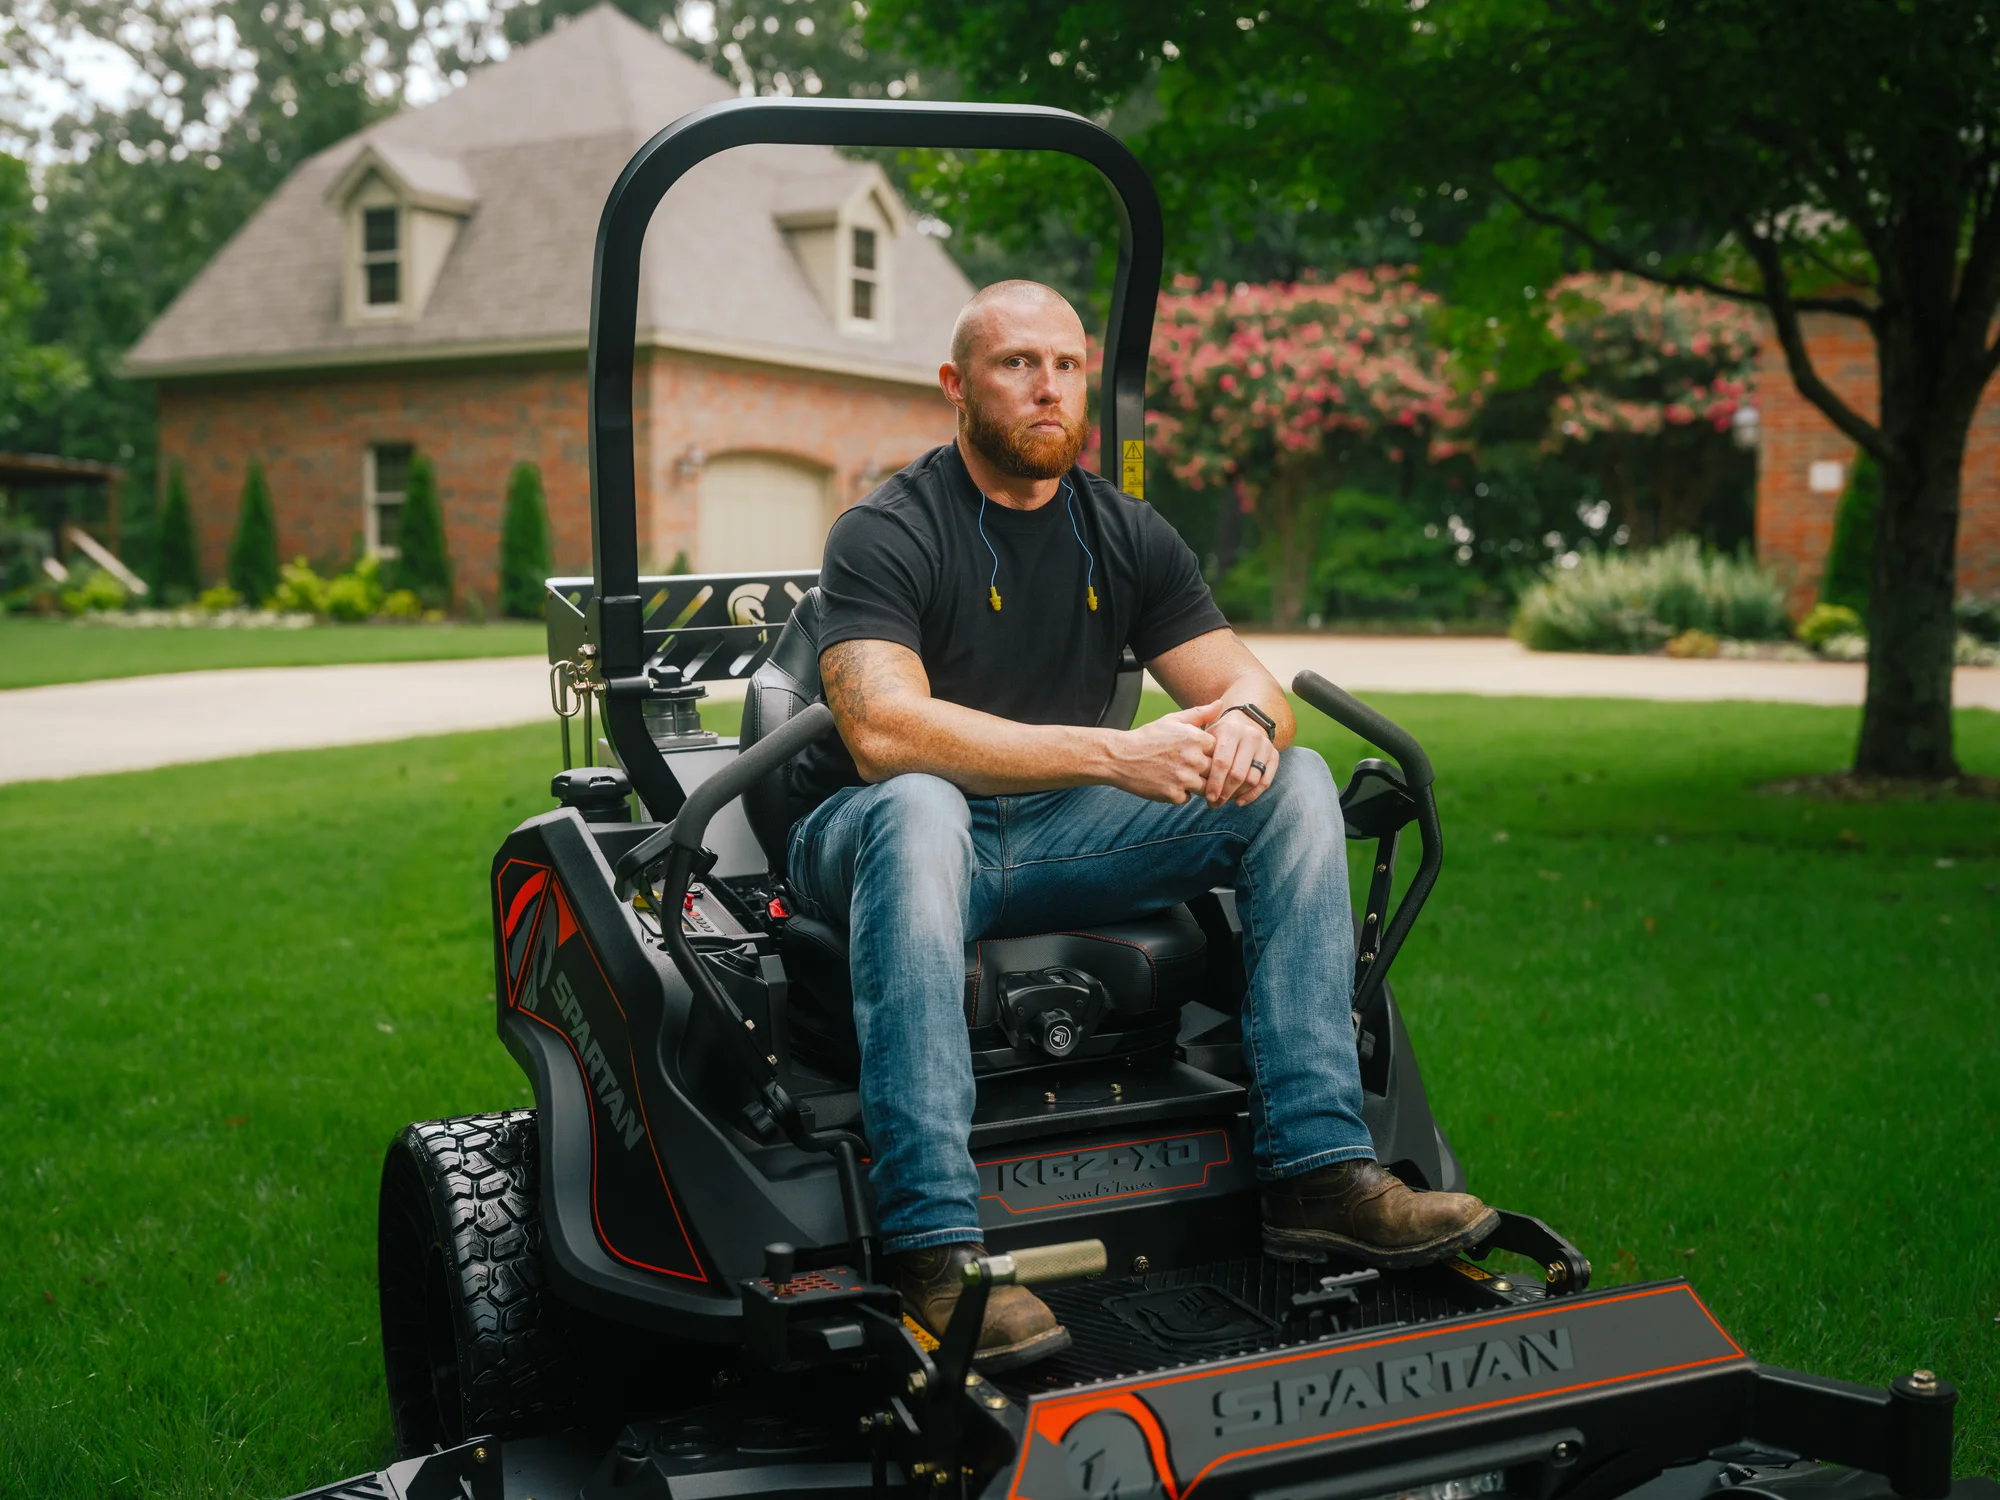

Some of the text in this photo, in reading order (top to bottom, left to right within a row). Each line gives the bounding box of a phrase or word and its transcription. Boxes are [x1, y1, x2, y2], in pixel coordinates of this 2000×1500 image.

[551, 970, 645, 1151] SPARTAN
[998, 1138, 1200, 1191] KGZ-XD
[1212, 1327, 1576, 1437] SPARTAN
